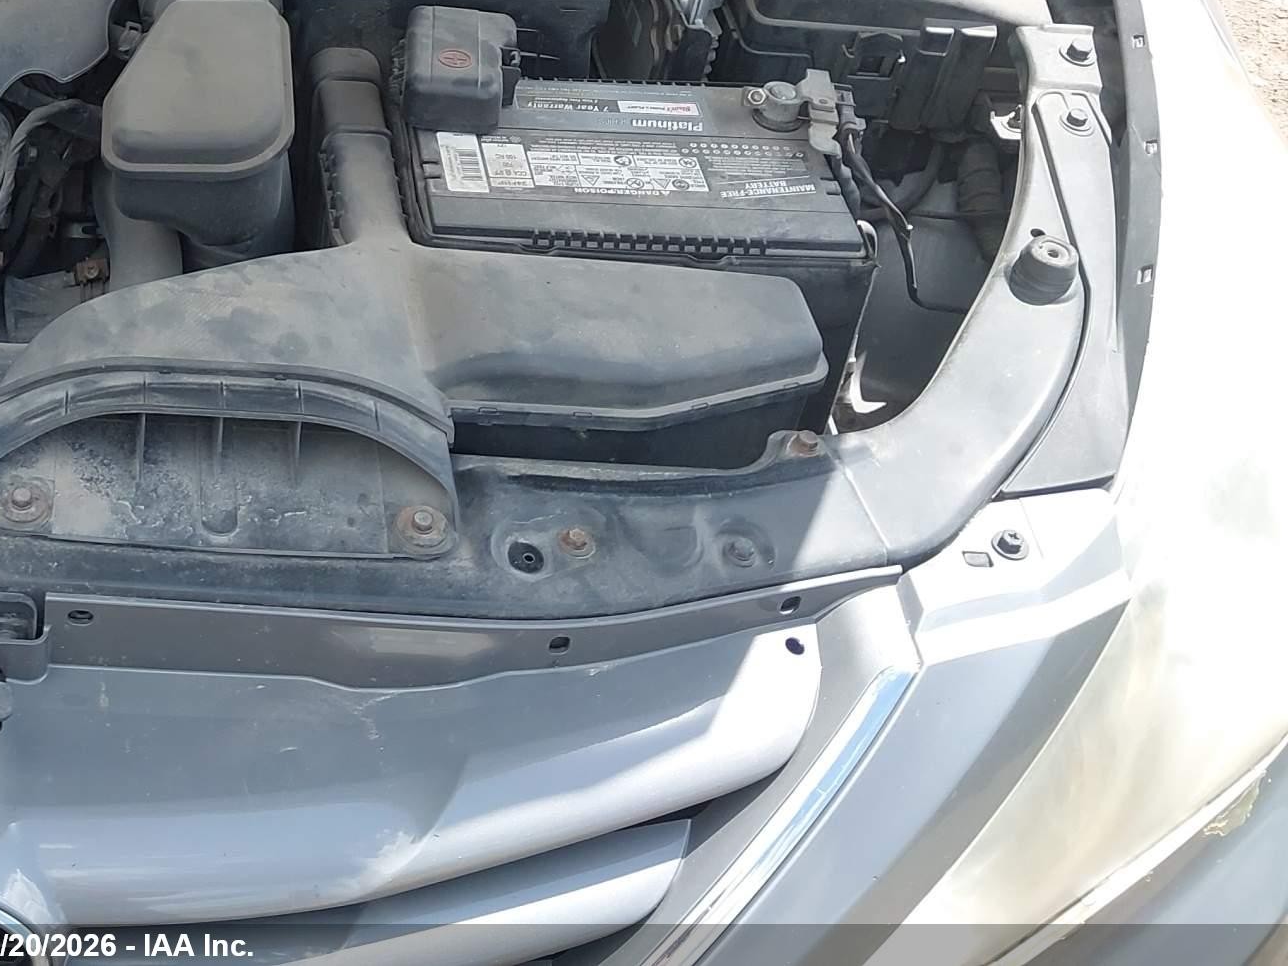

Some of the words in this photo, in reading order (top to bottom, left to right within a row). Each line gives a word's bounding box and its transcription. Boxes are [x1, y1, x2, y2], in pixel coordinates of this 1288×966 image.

[527, 101, 573, 111] Warranty
[577, 103, 599, 112] Year
[632, 119, 703, 132] Platinum
[745, 180, 787, 189] BATTERY
[720, 184, 815, 198] MAINTENANCE-FREE
